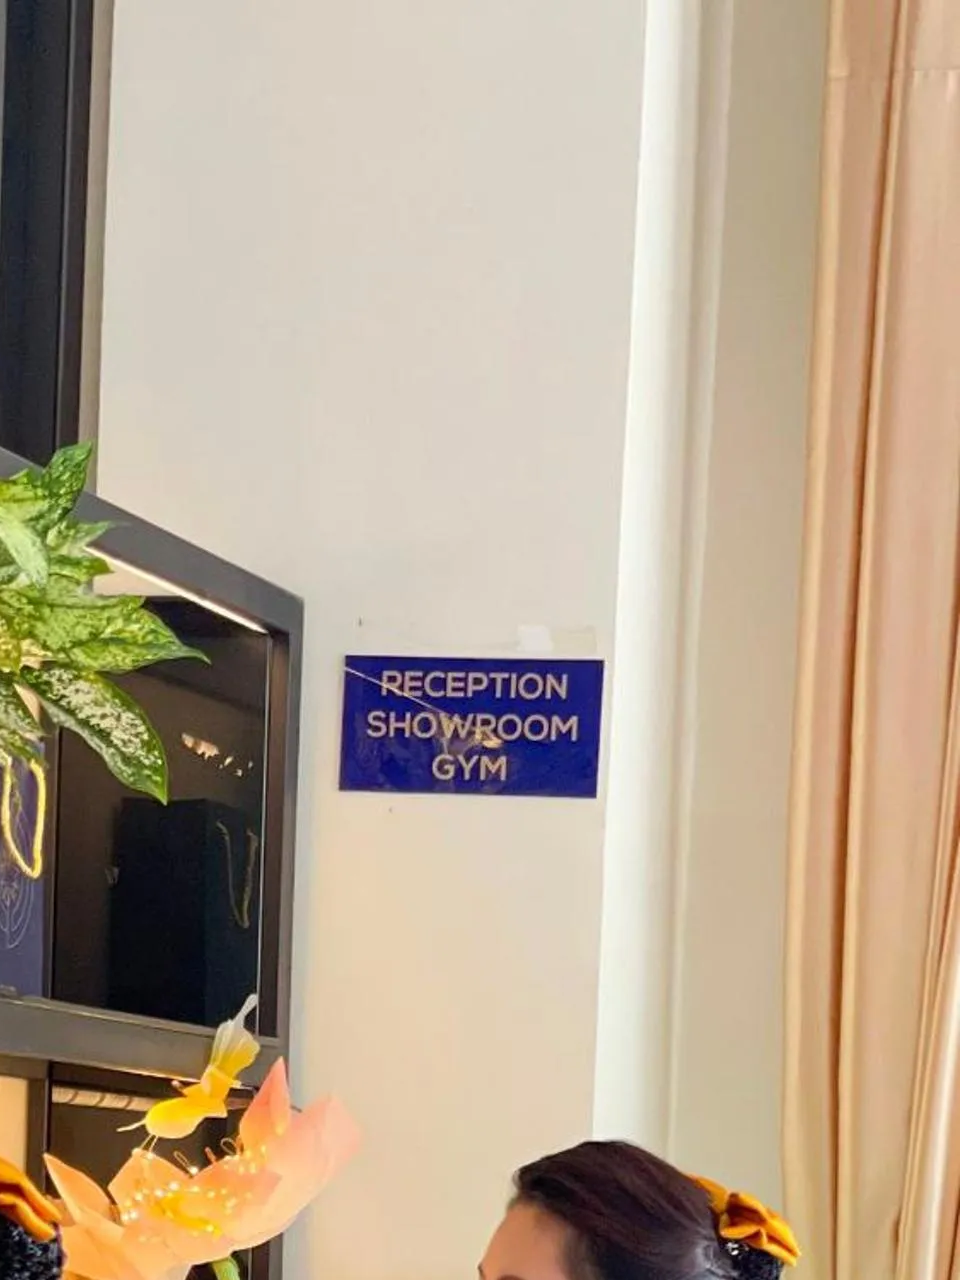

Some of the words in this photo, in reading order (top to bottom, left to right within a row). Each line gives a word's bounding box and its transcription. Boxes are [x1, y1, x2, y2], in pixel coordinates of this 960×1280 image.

[380, 670, 569, 700] RECEPTION
[366, 710, 579, 742] SHOWROOM
[431, 753, 508, 781] GYM
